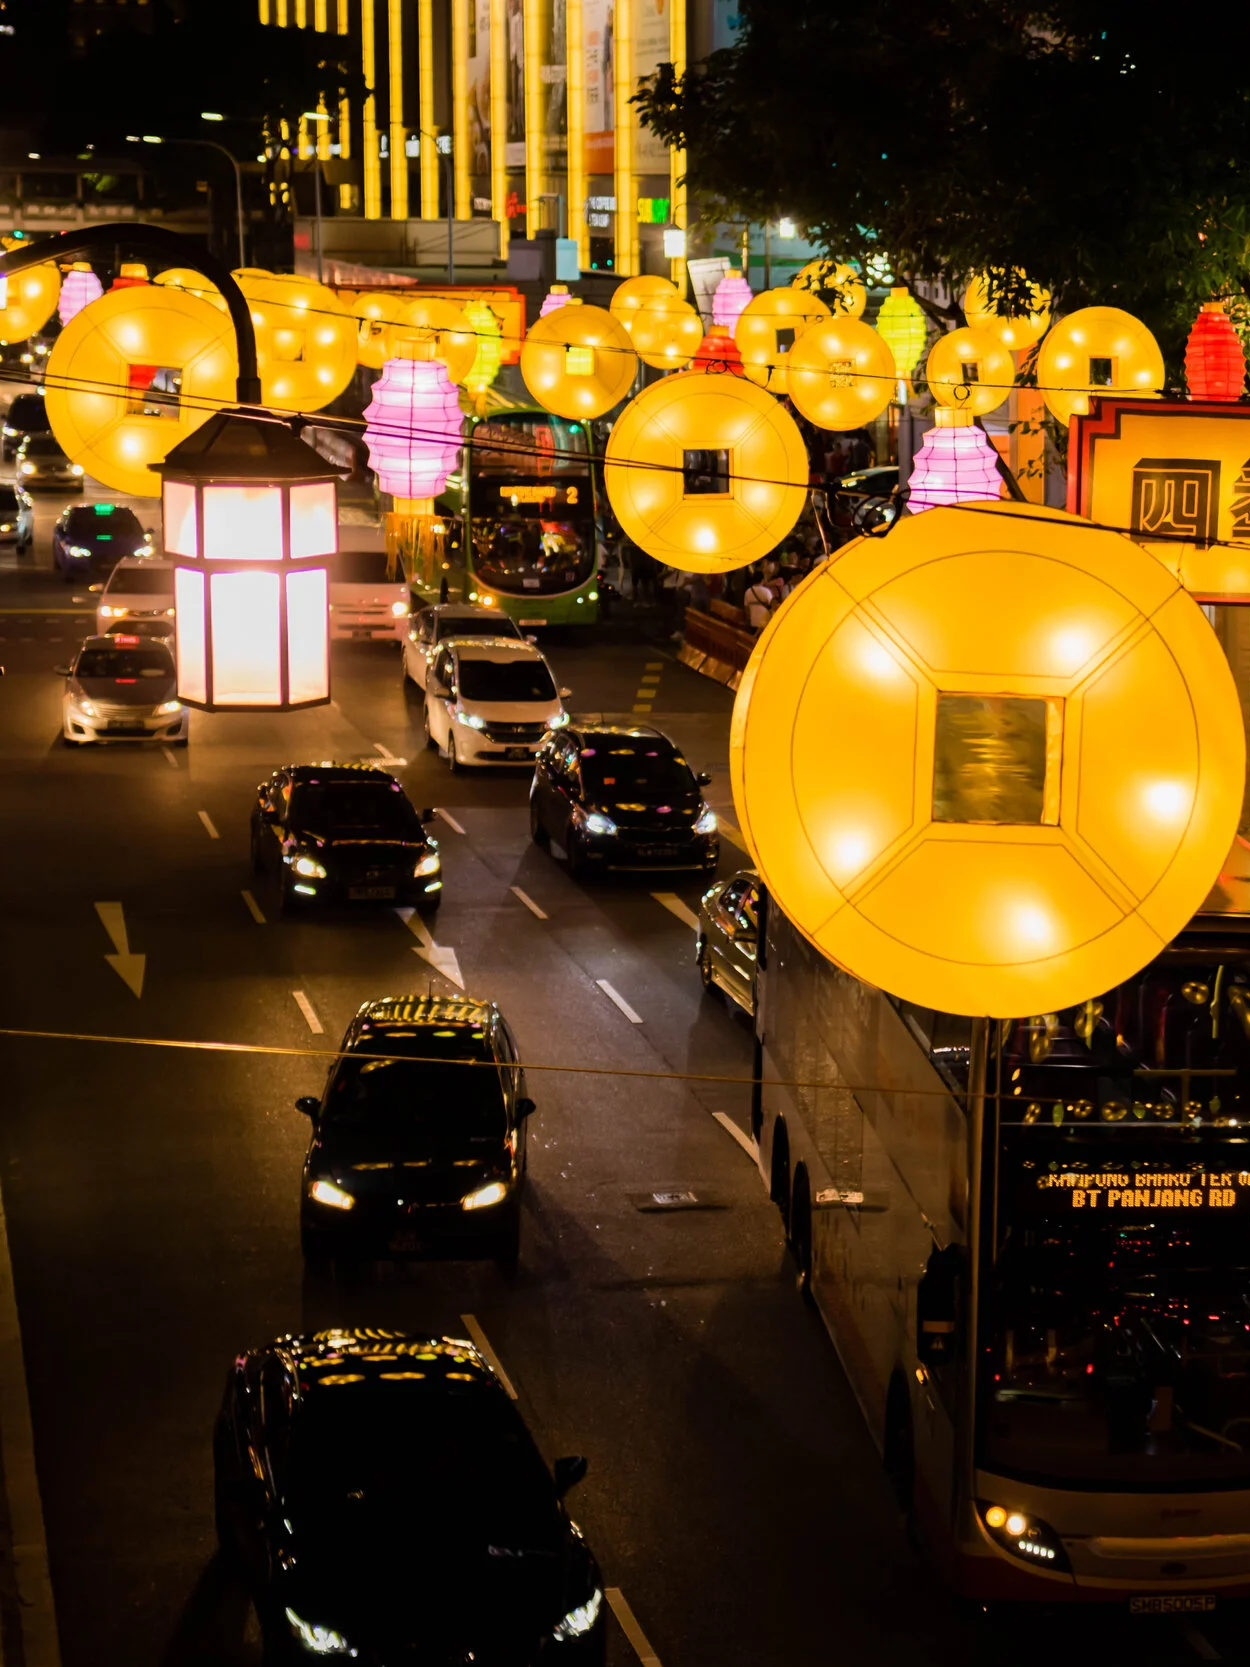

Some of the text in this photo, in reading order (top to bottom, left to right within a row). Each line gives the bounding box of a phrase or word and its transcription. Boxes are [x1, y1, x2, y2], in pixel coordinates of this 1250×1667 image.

[566, 485, 579, 505] 2
[1072, 1188, 1236, 1208] BT PANJANG RD
